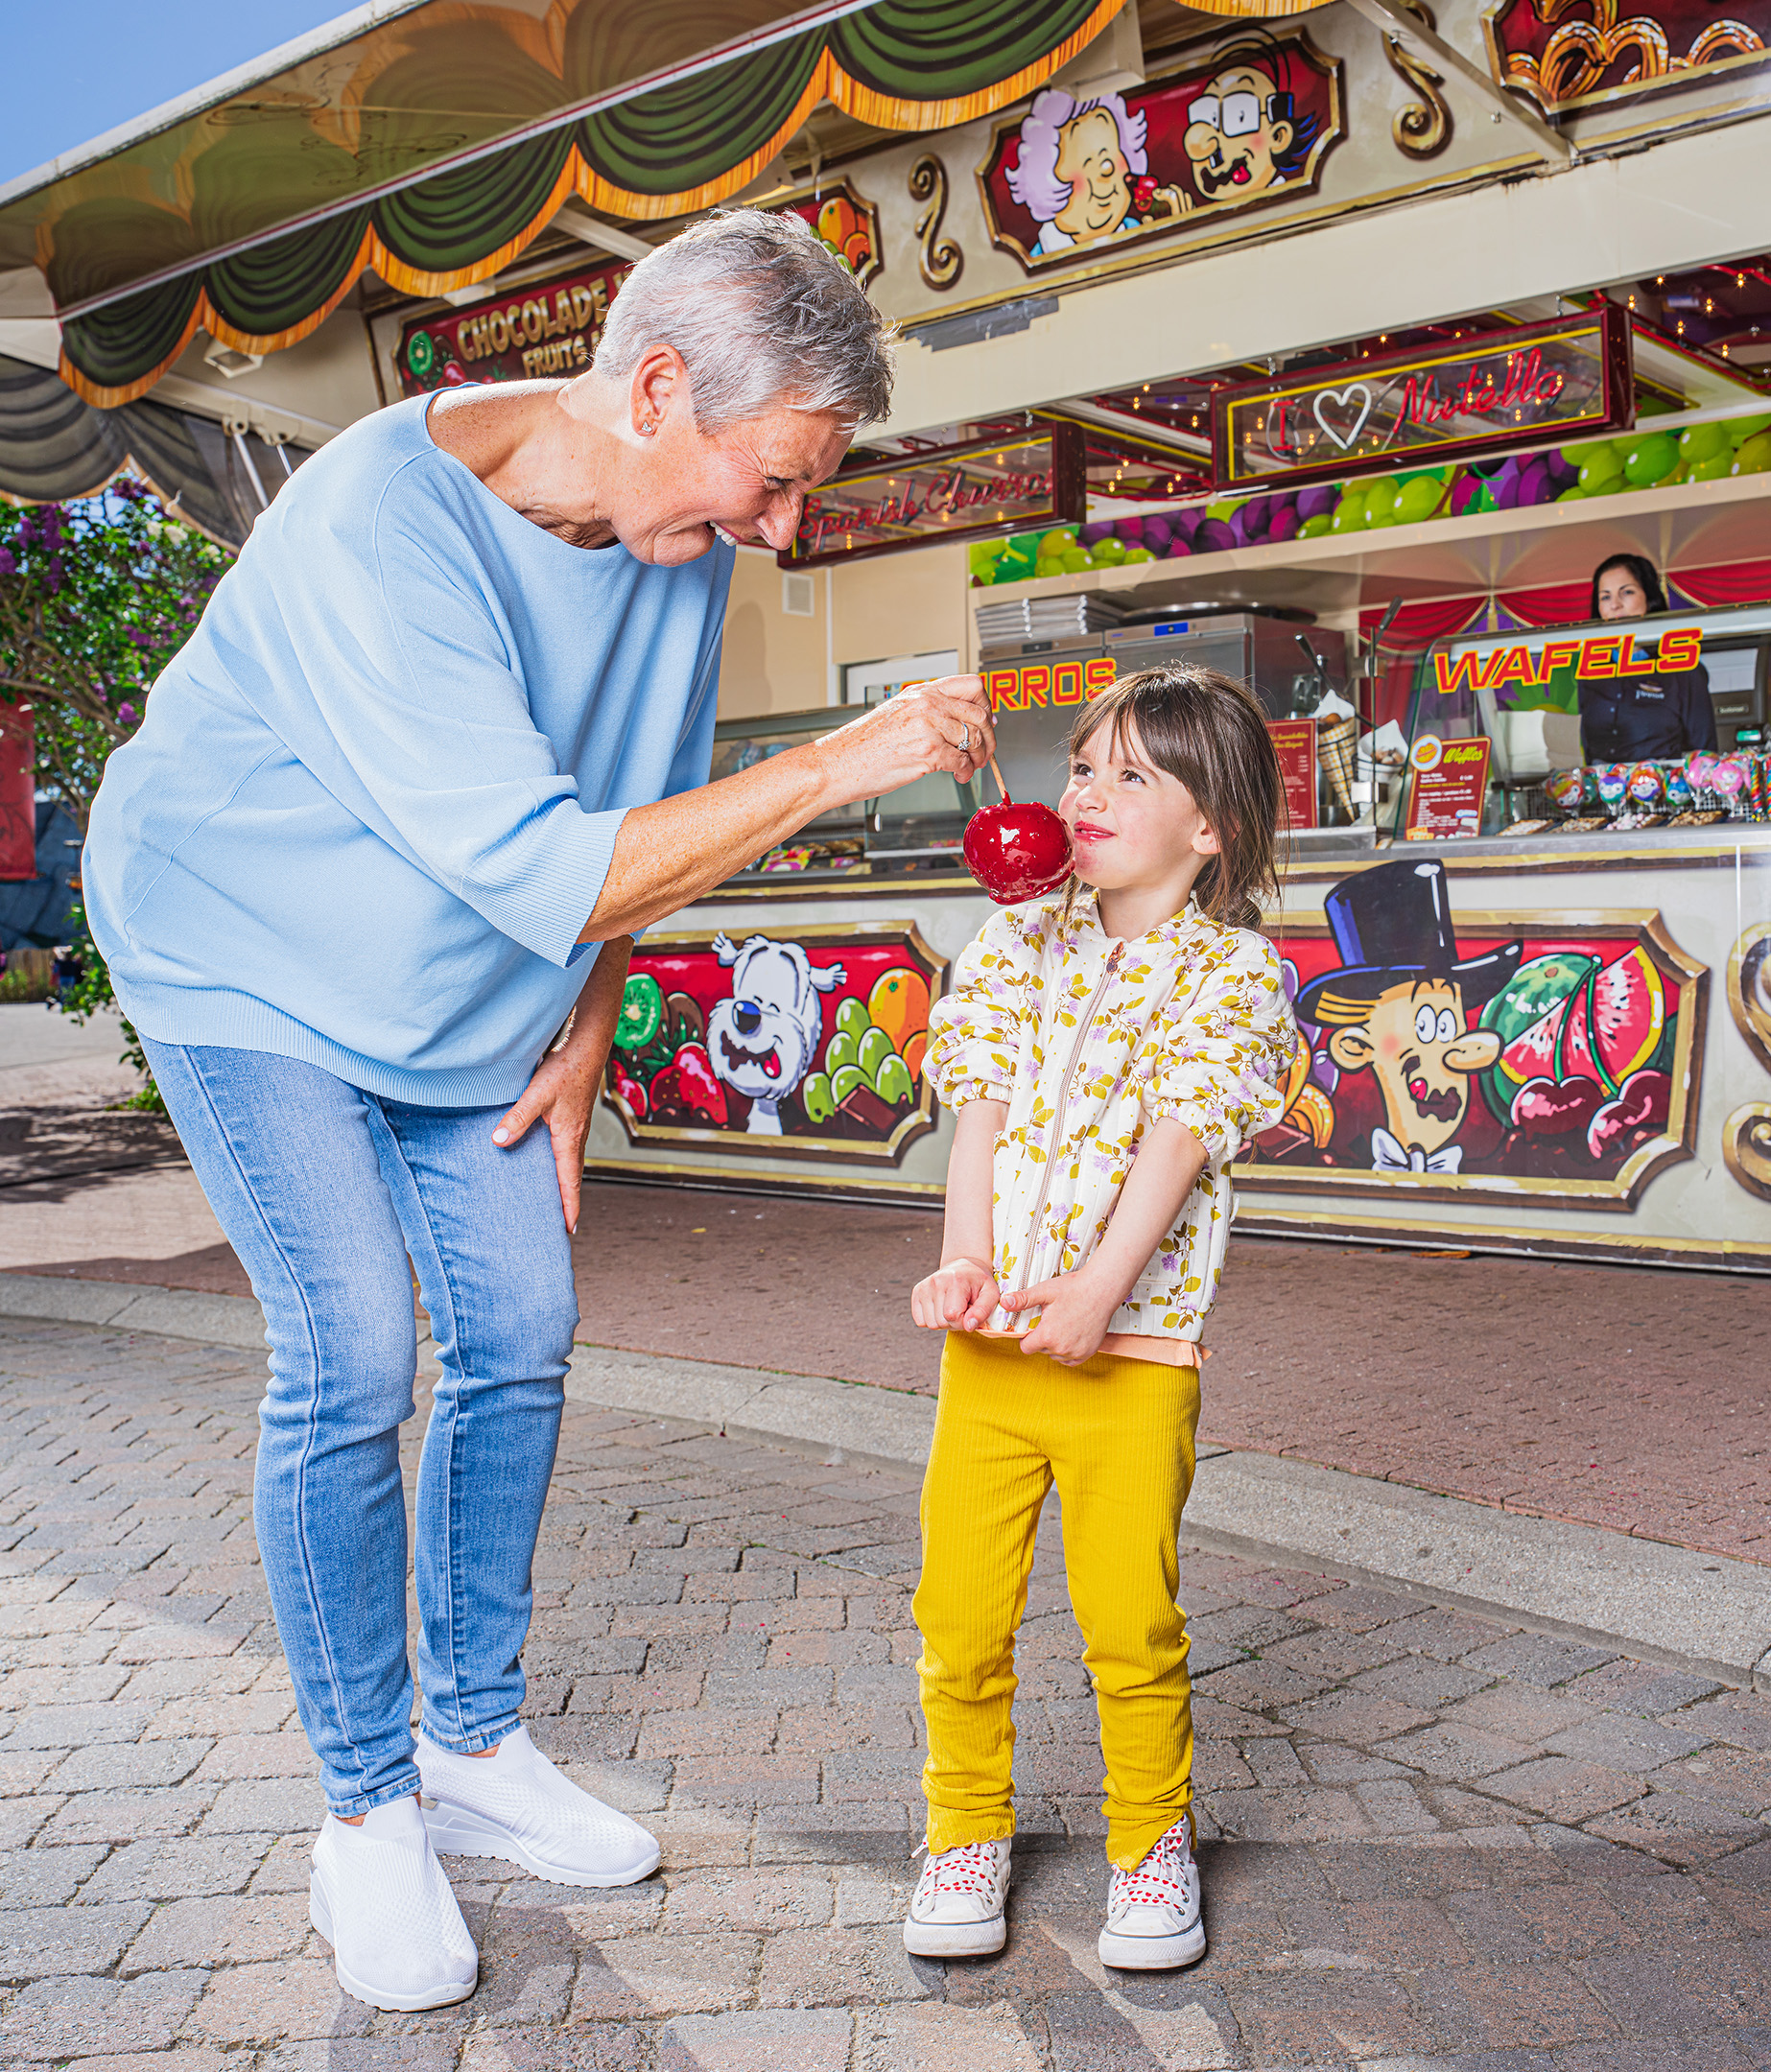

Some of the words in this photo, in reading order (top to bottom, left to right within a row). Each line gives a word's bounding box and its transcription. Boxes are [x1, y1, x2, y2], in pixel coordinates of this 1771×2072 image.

[457, 277, 609, 363] CHOCOLADE
[521, 335, 588, 378] FRUITS
[1271, 400, 1294, 451] I
[1393, 347, 1565, 434] Nutella
[798, 479, 919, 553] Spanish
[924, 467, 1053, 514] Churros
[1434, 627, 1704, 695] WAFELS
